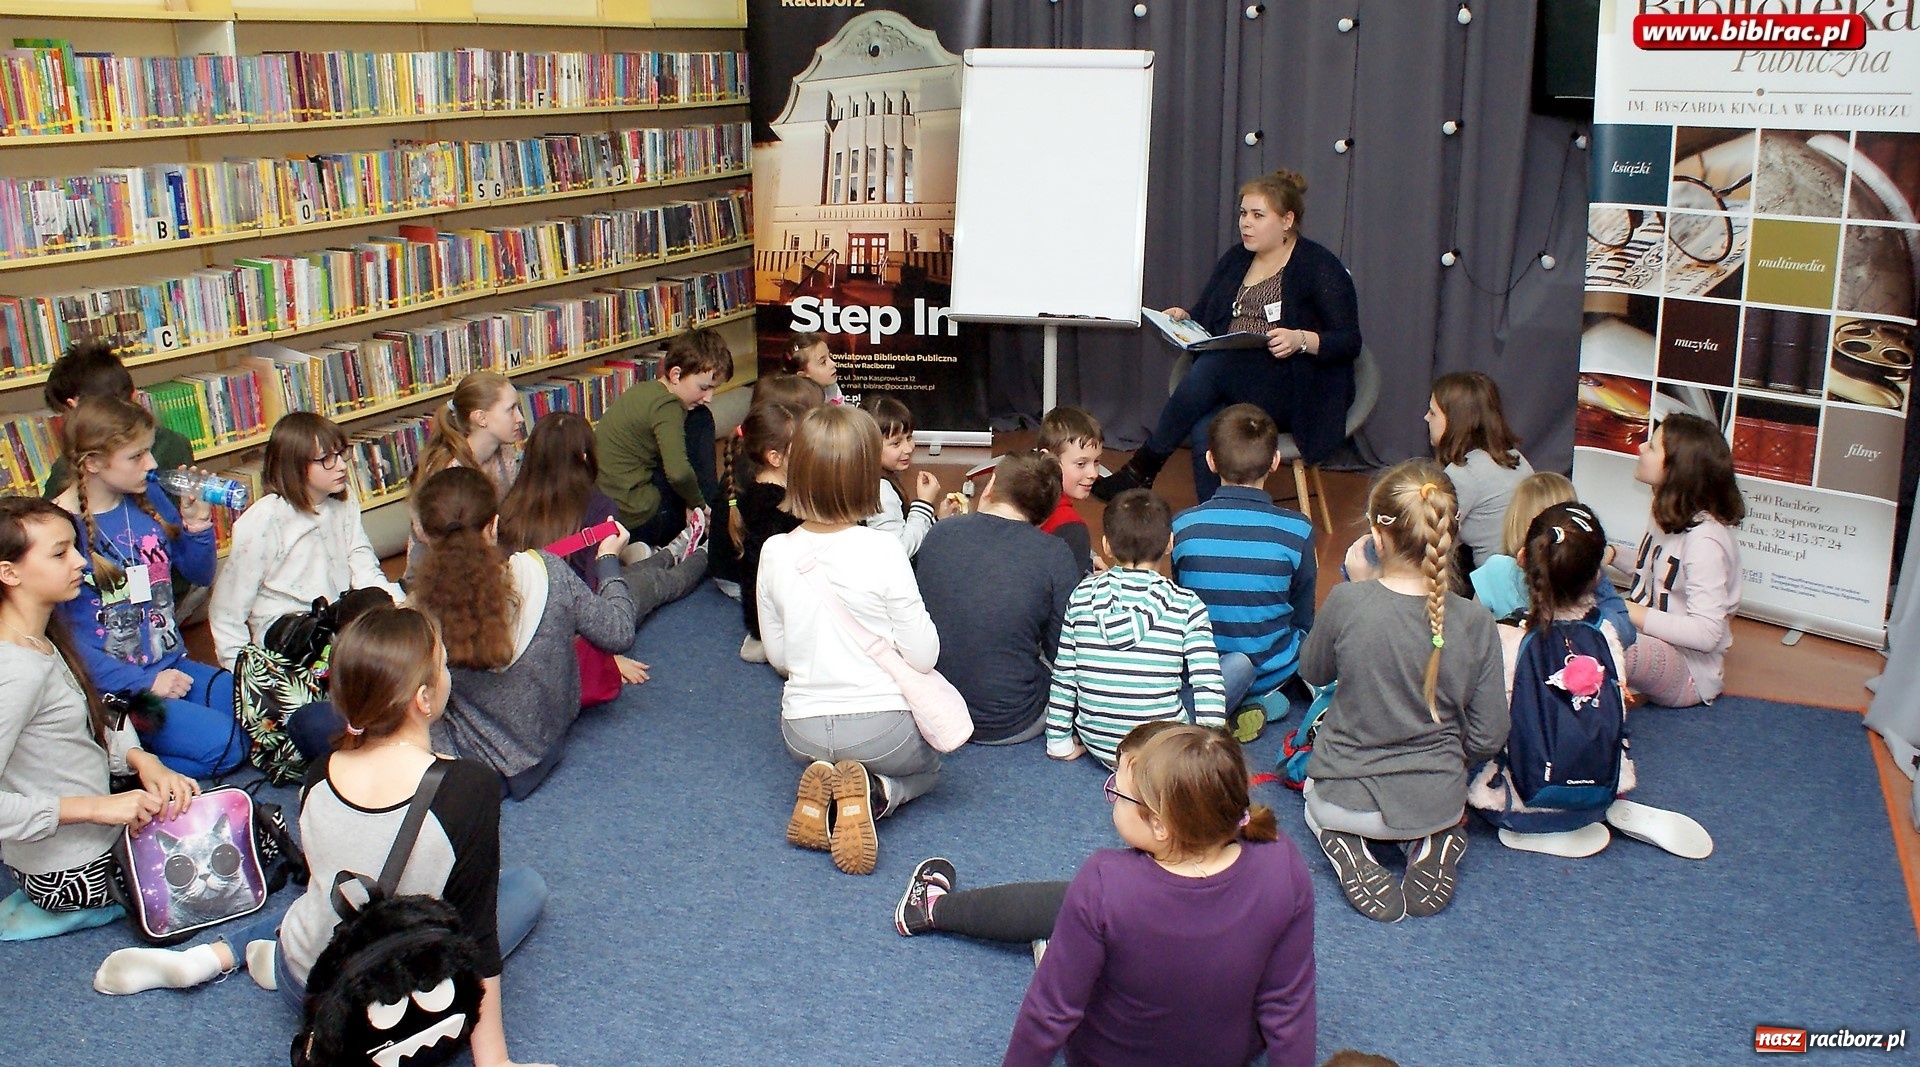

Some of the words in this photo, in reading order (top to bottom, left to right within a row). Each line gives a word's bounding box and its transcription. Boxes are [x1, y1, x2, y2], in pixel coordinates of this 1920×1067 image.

[1655, 100, 1725, 114] RYSZARDA
[1794, 103, 1808, 115] W
[1814, 103, 1913, 118] RACIBORZU
[157, 220, 167, 240] B
[1757, 256, 1826, 273] multimedia
[789, 295, 902, 345] Step
[162, 330, 172, 348] C
[1674, 336, 1719, 353] muzyka
[510, 351, 521, 368] M
[873, 353, 916, 362] Biblioteka
[917, 354, 958, 363] Publiczna
[1844, 443, 1883, 462] filmy
[1774, 495, 1820, 514] Racibórz
[1773, 511, 1839, 534] Kasprowicza
[1844, 525, 1857, 537] 12
[1771, 528, 1786, 540] 32
[1739, 539, 1807, 561] ww.biblrac.pl
